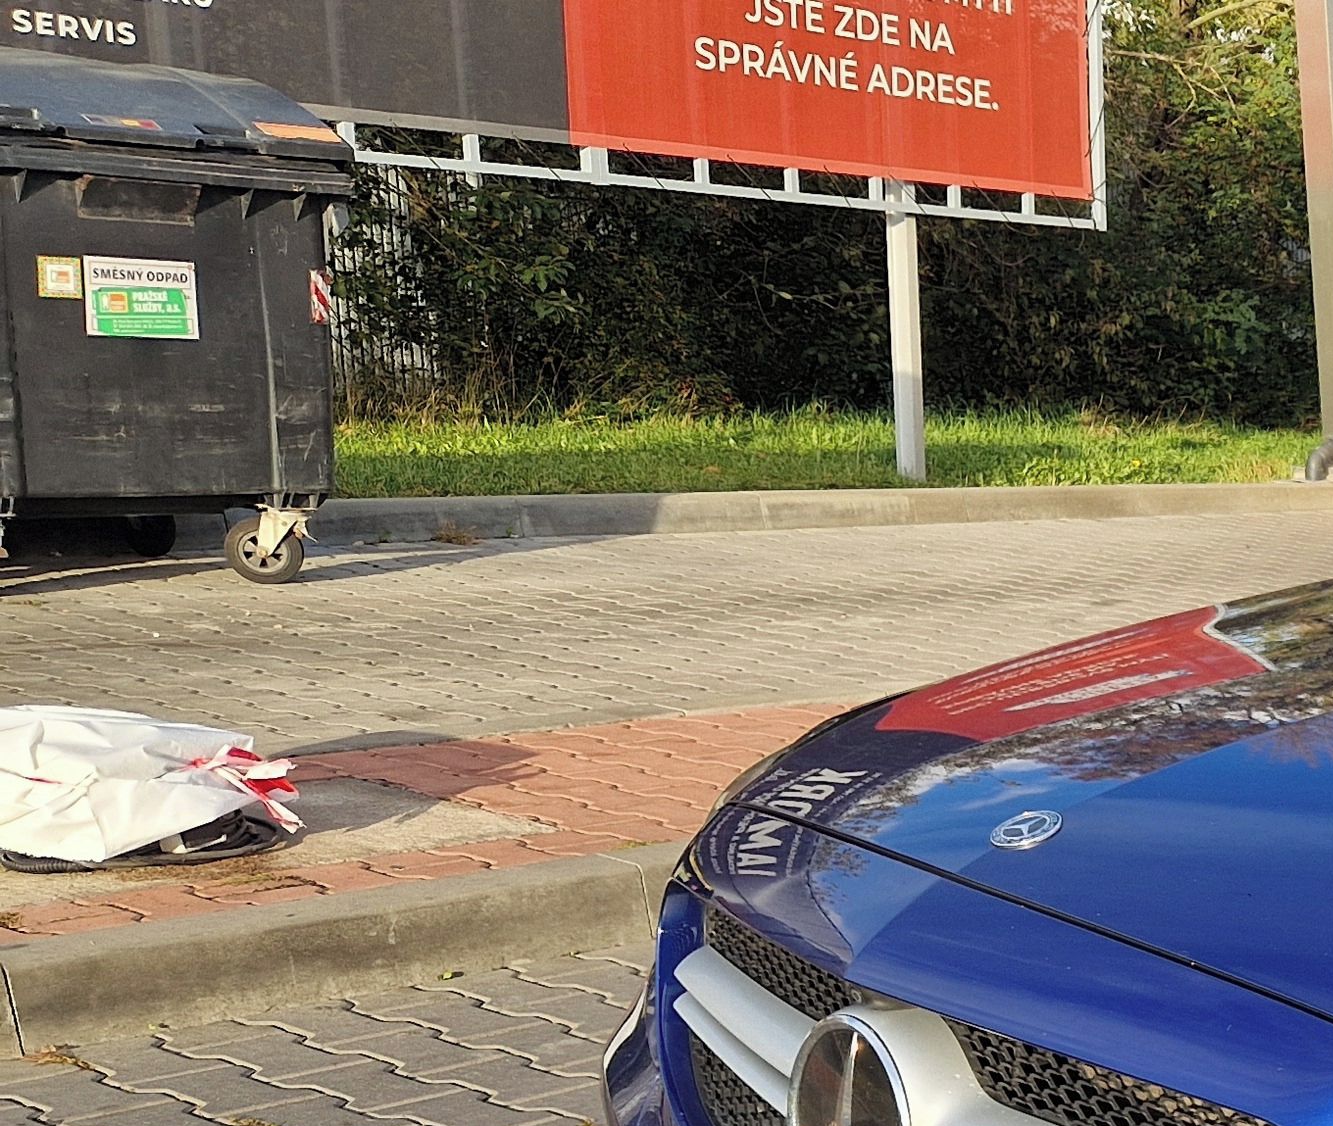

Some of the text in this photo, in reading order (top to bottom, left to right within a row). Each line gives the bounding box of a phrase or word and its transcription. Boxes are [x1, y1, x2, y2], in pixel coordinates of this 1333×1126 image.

[12, 9, 137, 46] SERVIS
[744, 0, 825, 33] JSTE
[834, 5, 900, 46] ZDE
[909, 18, 956, 55] NA
[694, 36, 1000, 111] SPRÁVNÉ ADRESE.
[147, 271, 188, 283] ODPAD
